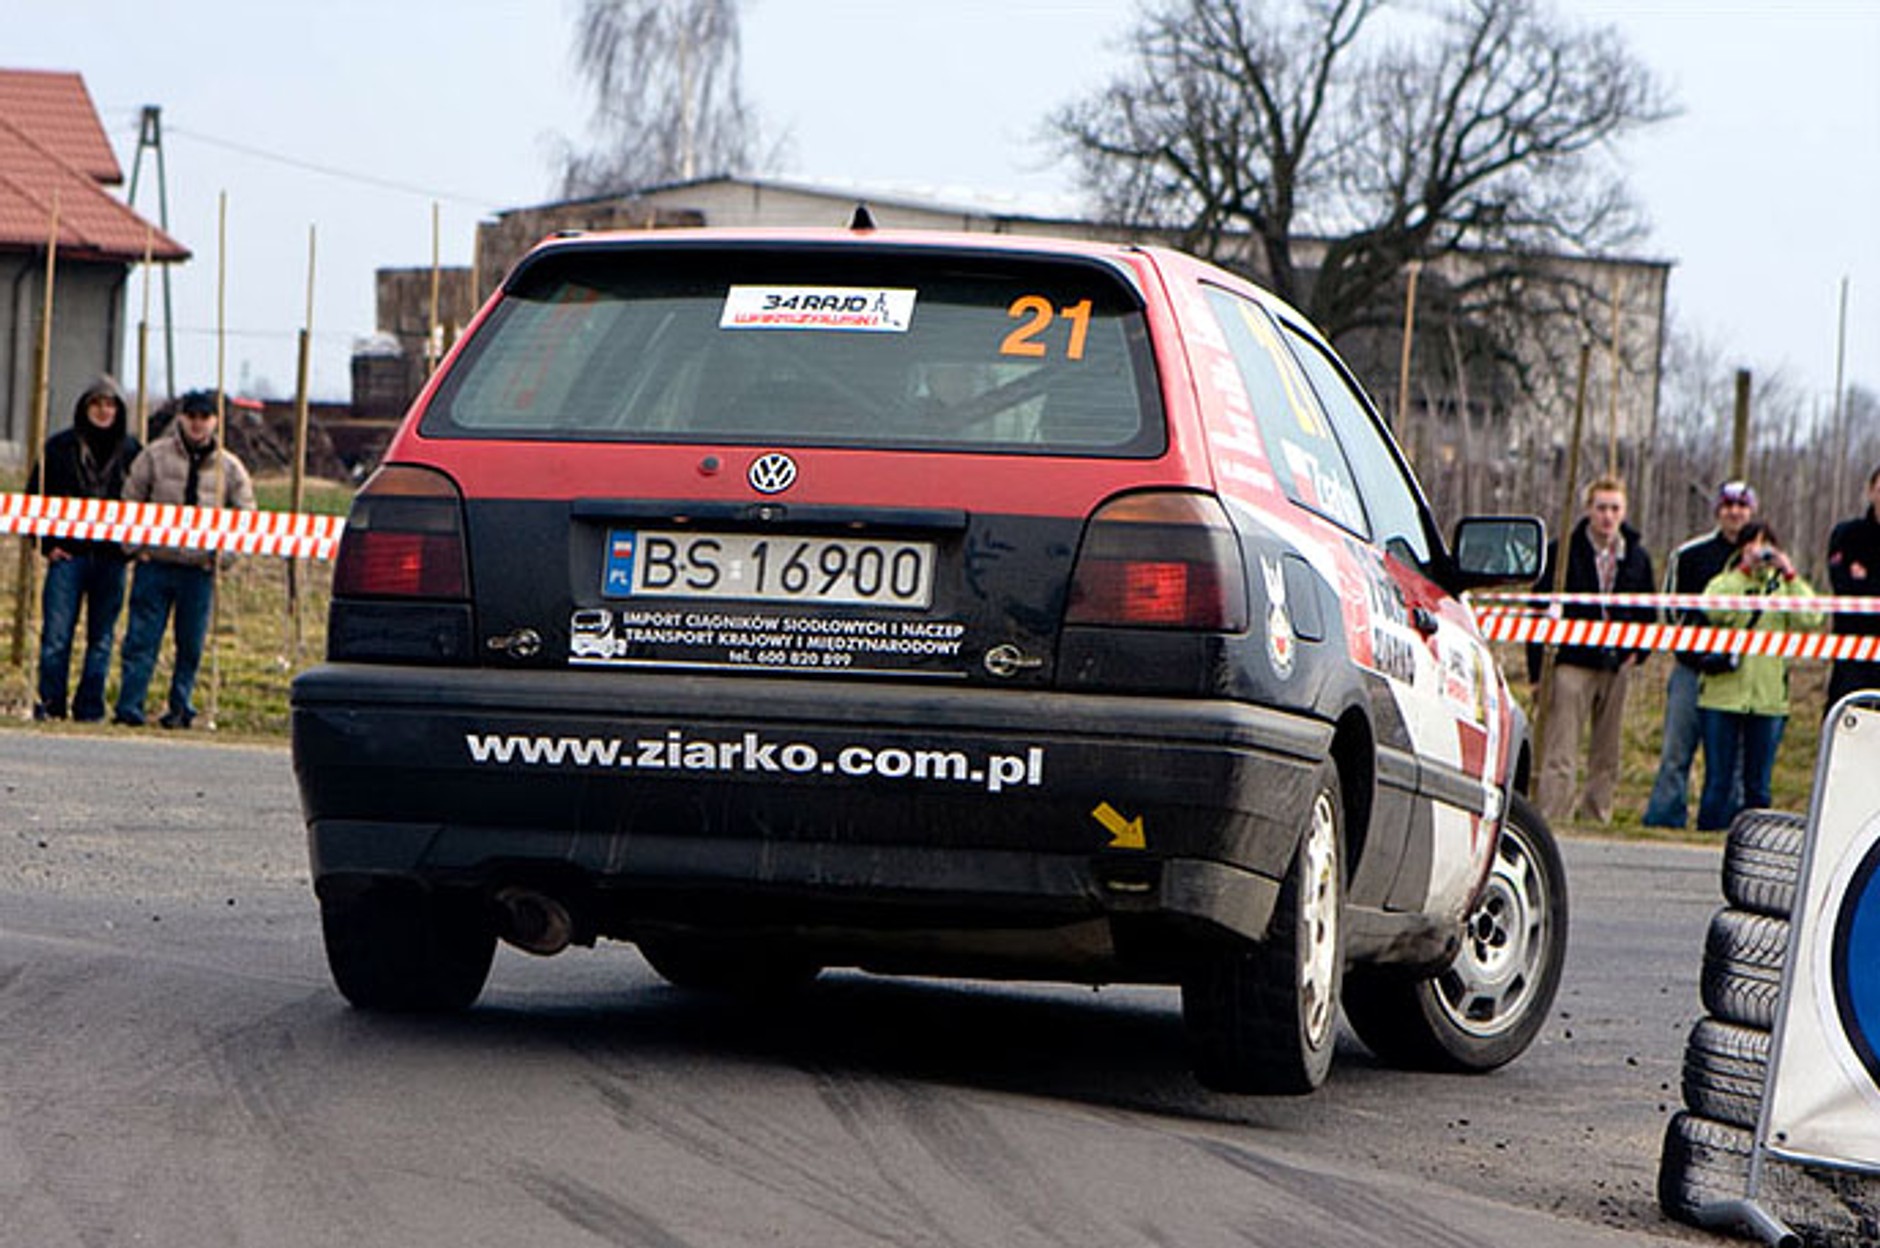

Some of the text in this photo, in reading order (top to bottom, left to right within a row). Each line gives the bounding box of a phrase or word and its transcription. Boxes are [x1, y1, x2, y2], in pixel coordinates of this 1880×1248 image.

[999, 294, 1093, 359] 21
[608, 569, 628, 586] PL
[641, 537, 921, 599] BS 16900
[623, 611, 682, 627] IMPORT
[890, 622, 898, 636] I
[901, 621, 965, 638] NACZEP
[624, 628, 714, 645] TRANSPORT
[718, 631, 793, 648] KRAJOWY
[756, 651, 786, 664] 600
[465, 731, 1044, 792] www.ziarko.com.pl
